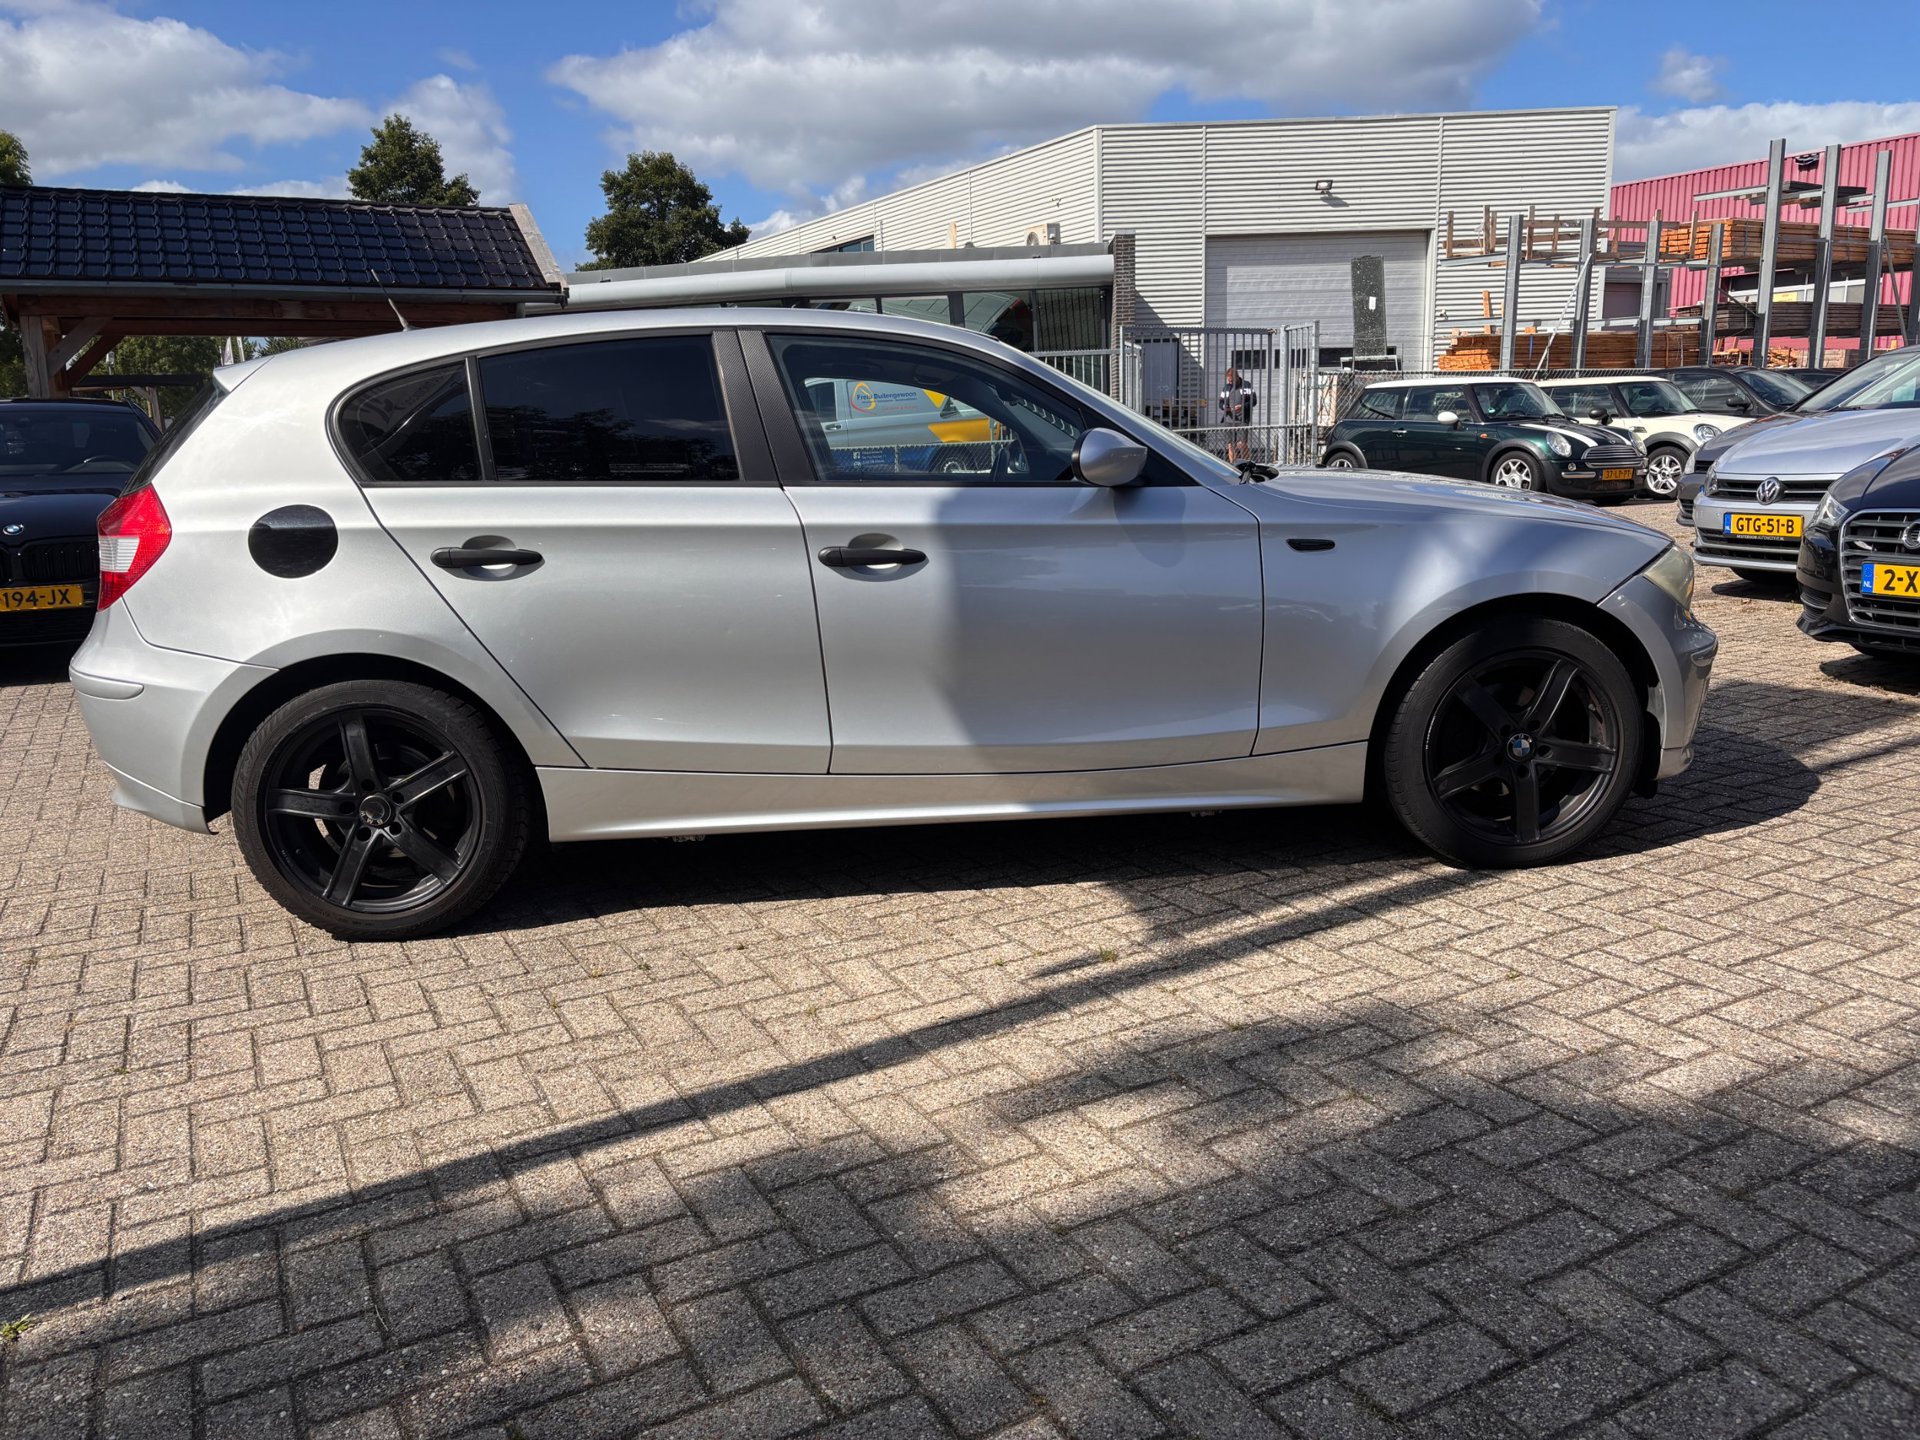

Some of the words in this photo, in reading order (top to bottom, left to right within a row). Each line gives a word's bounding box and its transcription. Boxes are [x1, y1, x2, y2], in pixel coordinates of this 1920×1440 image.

[1736, 517, 1795, 534] GTG-51-B
[1863, 580, 1872, 588] NL
[1883, 569, 1919, 593] 2-X
[0, 588, 71, 608] 194-JX
